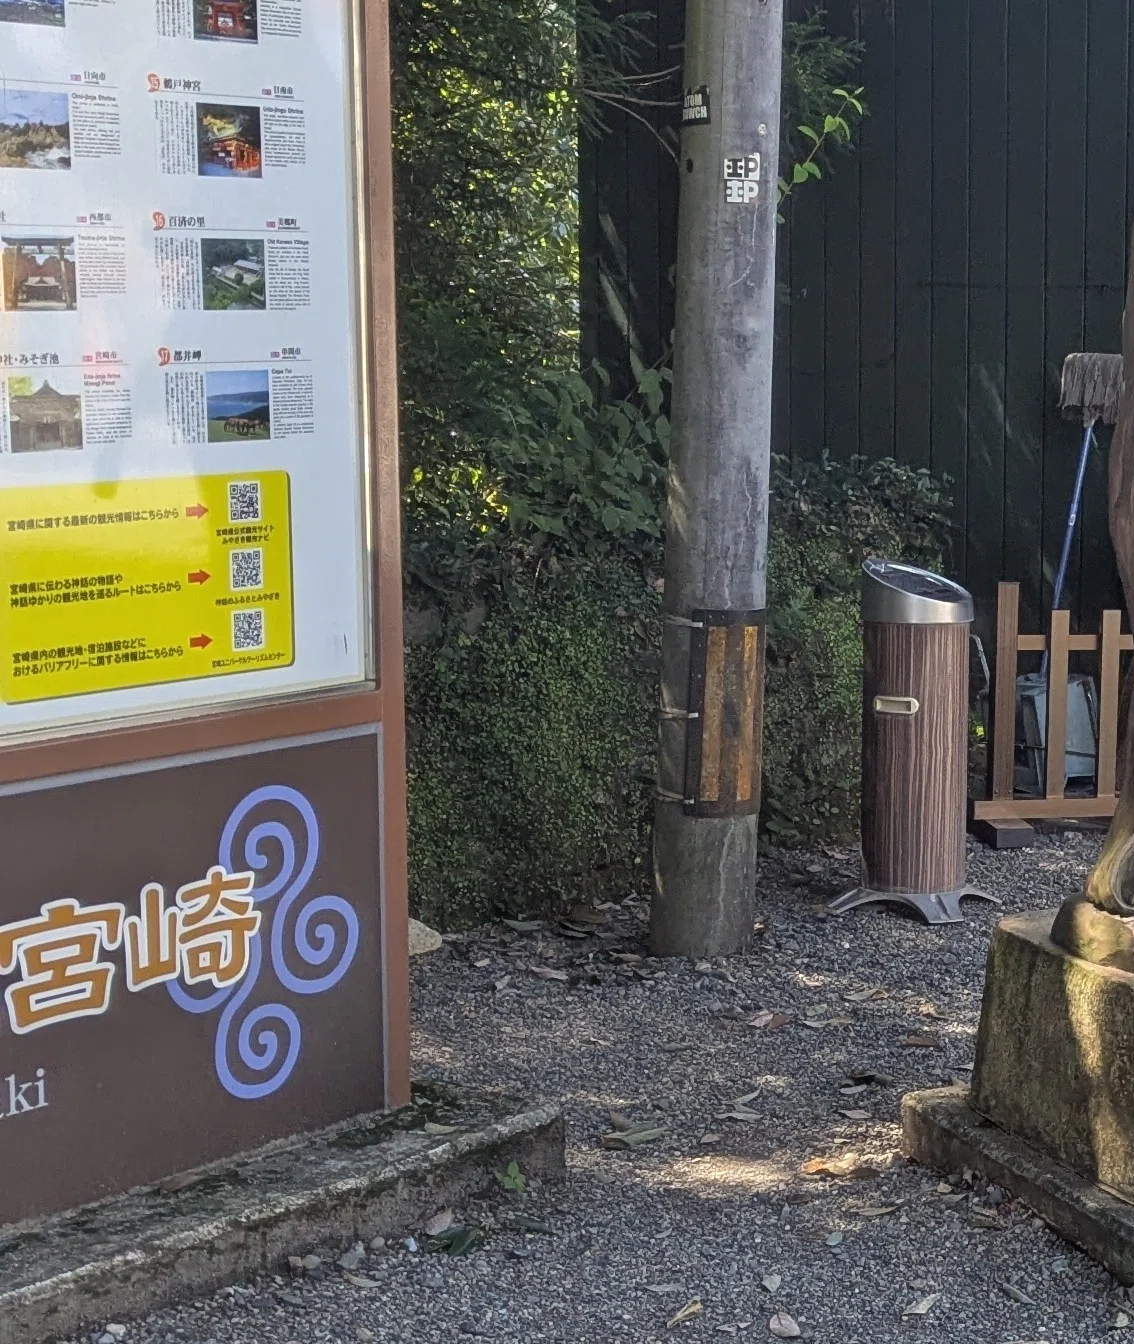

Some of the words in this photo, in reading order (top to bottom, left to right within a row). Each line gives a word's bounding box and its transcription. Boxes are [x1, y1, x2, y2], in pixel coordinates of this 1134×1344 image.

[168, 215, 206, 228] 百済の里
[0, 352, 60, 366] 社・みそぎ池
[173, 349, 202, 362] 都井岬
[7, 507, 179, 532] 宮崎県に関する最新の観光情報はこちらから
[9, 573, 123, 596] 宮崎県に伝わる神話の物語や
[10, 580, 182, 609] 神話ゆかりの観光地を巡るルートはこちらから
[12, 637, 147, 664] 宮崎県内の観光地・宿泊施設などに
[13, 645, 184, 678] おけるバリアフリーに関する情報はこちらから
[0, 865, 262, 1035] 宮崎
[0, 1067, 49, 1118] ki
